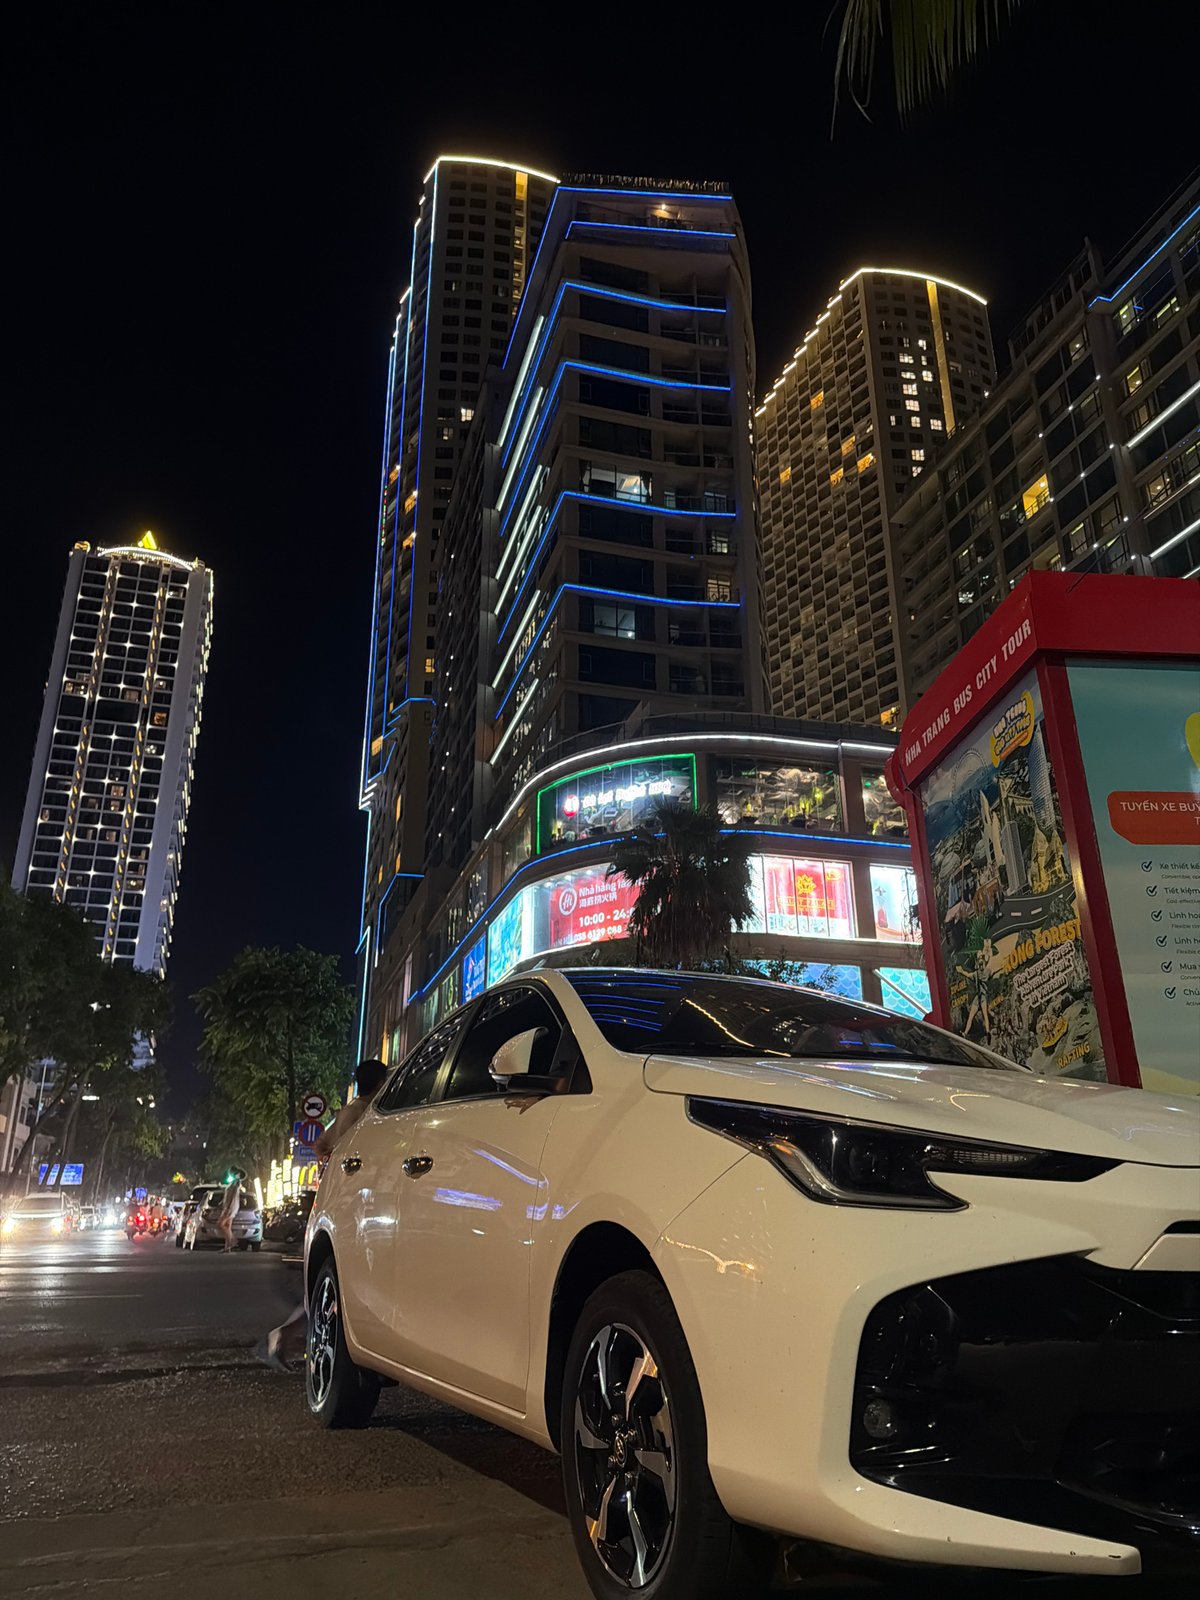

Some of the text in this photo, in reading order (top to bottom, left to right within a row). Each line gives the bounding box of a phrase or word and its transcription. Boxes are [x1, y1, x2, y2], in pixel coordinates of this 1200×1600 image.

[905, 619, 1032, 766] NHA TRANG BUS CITY TOUR
[1120, 800, 1159, 812] TUYẾN
[1162, 802, 1177, 812] XE
[1159, 862, 1169, 870] Xe
[579, 885, 595, 897] Nhà
[595, 881, 617, 893] hàng
[579, 913, 605, 928] 10:00
[1169, 911, 1187, 919] Linh
[1034, 918, 1082, 955] FOREST
[1174, 936, 1192, 945] Linh
[1050, 943, 1072, 962] Forest
[1037, 975, 1066, 999] Vietnam
[1057, 1041, 1090, 1069] RAFTING
